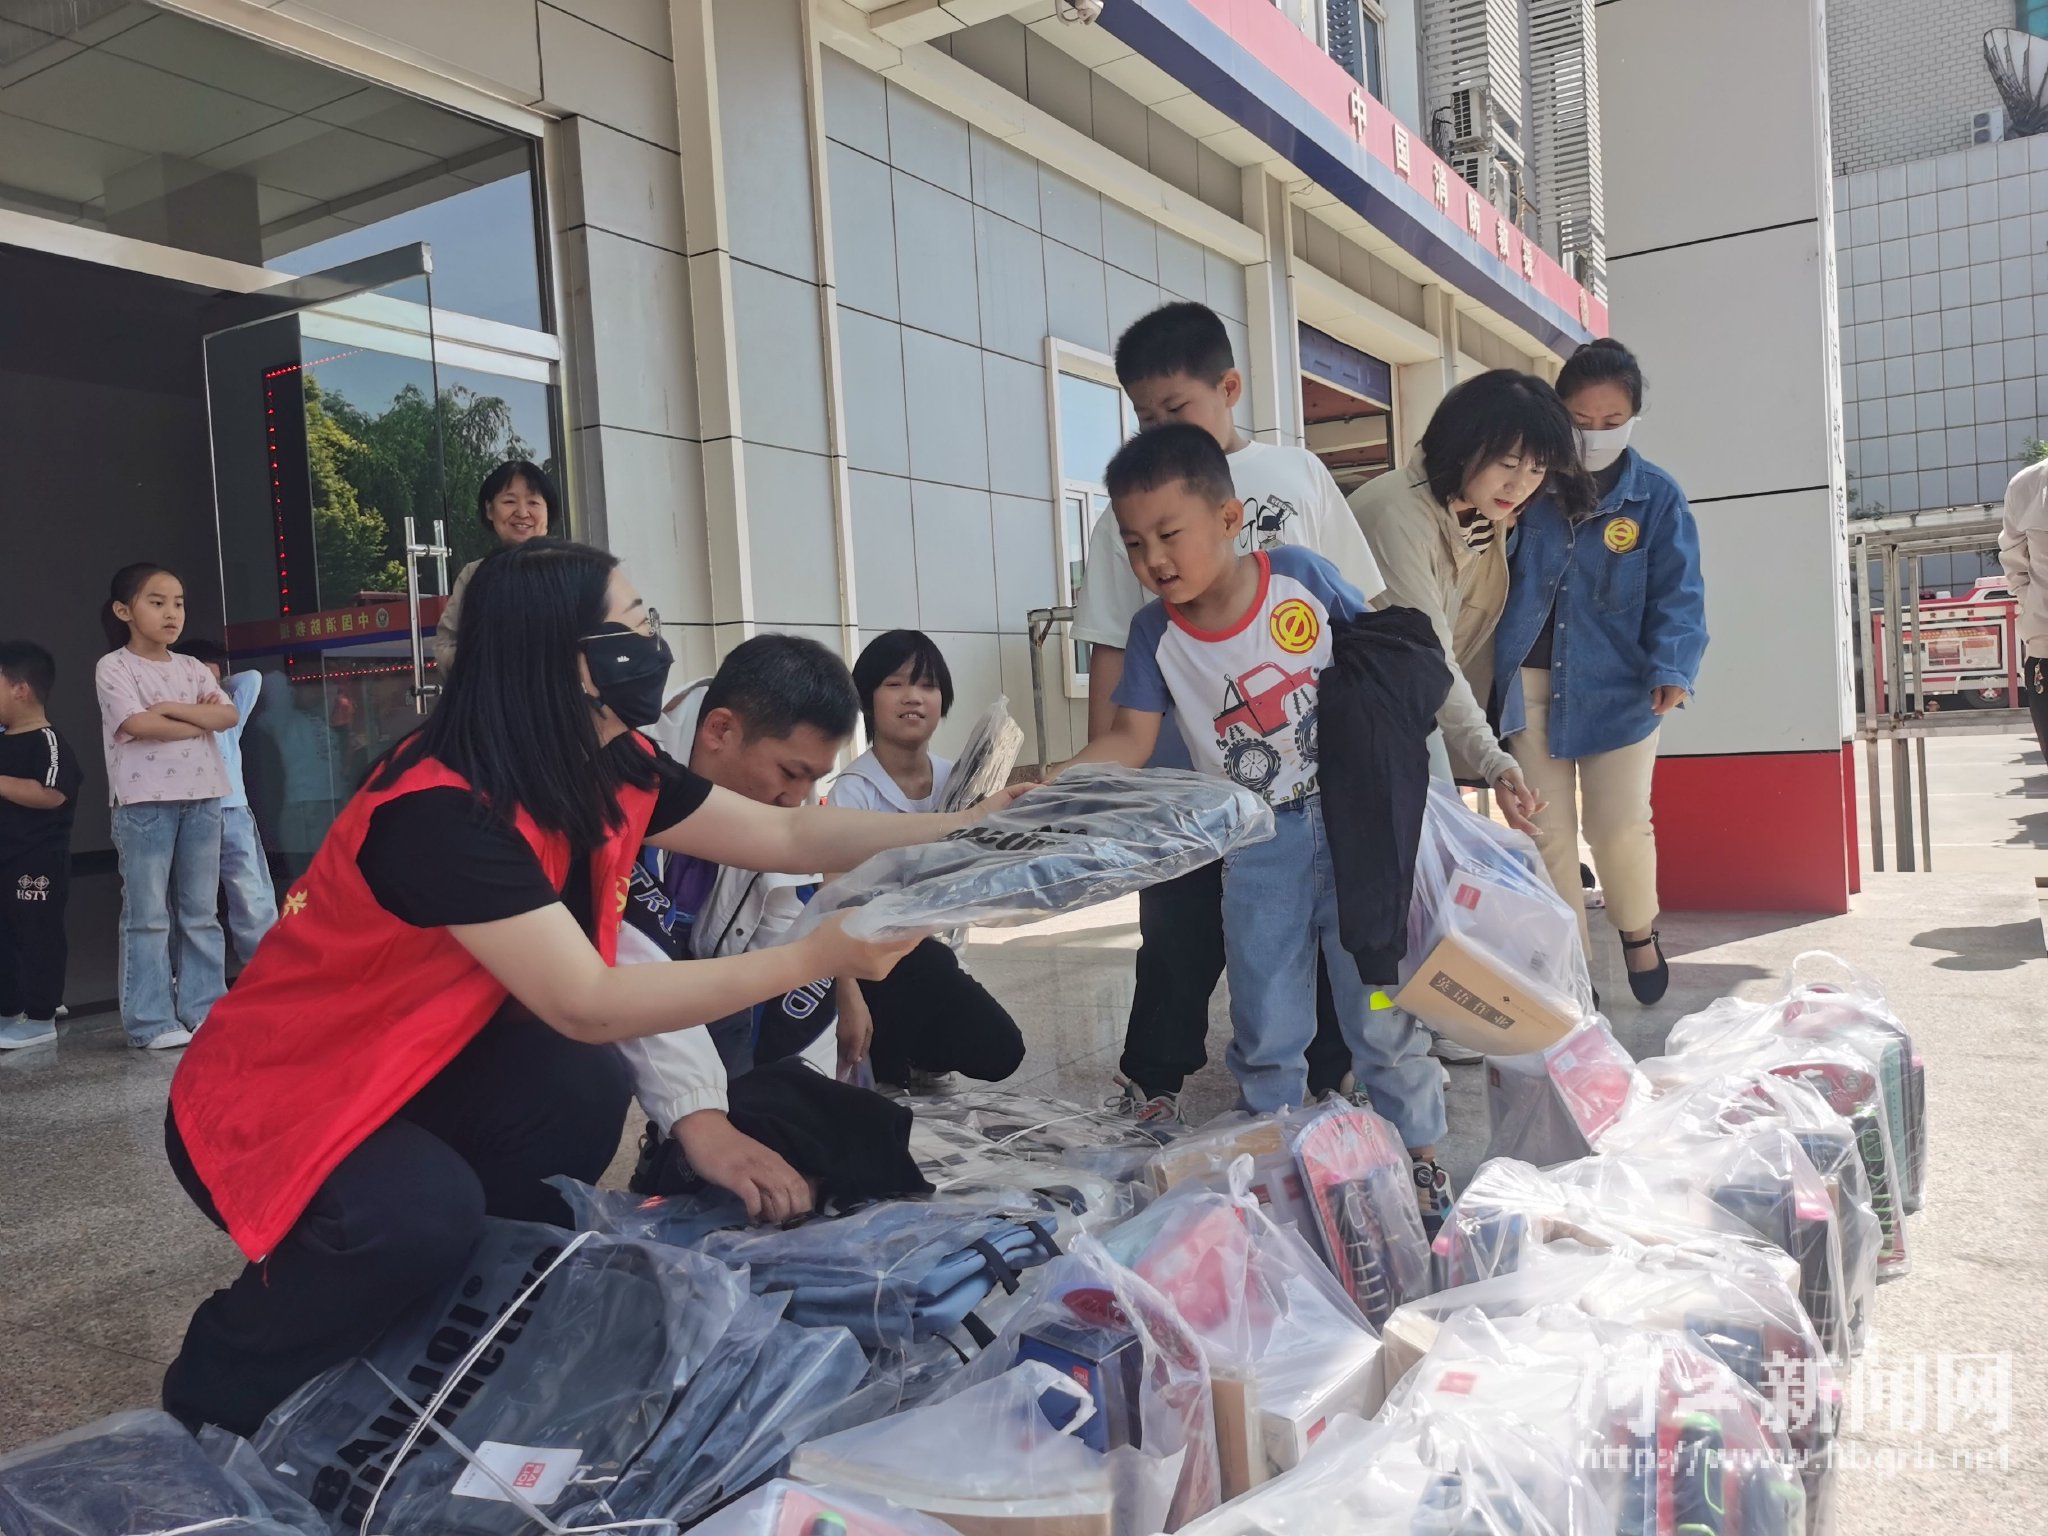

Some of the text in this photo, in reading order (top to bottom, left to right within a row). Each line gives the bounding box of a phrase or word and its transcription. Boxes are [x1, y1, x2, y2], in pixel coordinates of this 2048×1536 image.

[1350, 87, 1533, 278] 中国消防救援
[1436, 975, 1512, 1029] 英语作业
